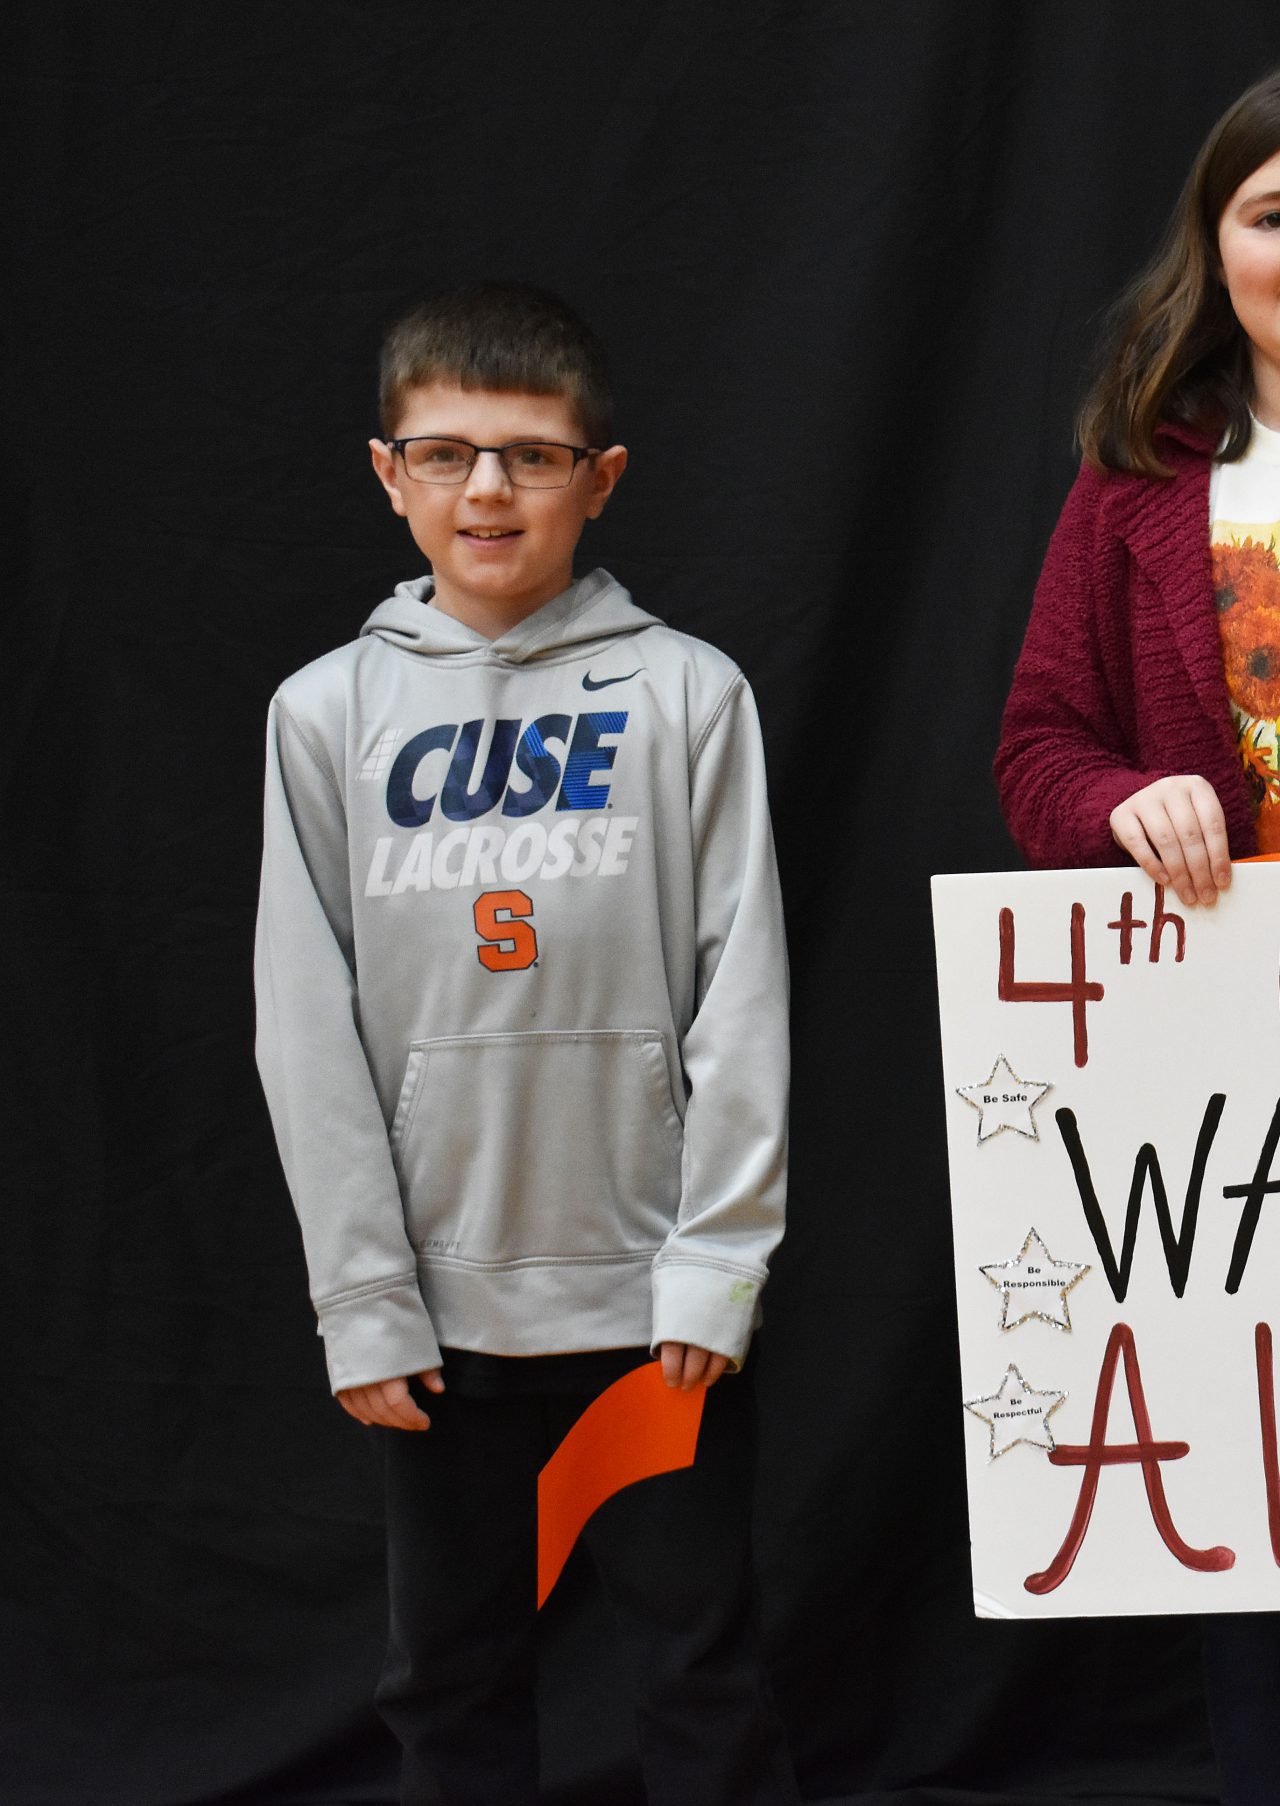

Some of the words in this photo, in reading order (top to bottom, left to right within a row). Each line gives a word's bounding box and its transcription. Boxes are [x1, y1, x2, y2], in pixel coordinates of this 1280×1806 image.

[386, 711, 629, 828] CUSE
[364, 816, 640, 898] LACROSSE
[473, 889, 539, 973] S
[998, 882, 1186, 1068] 4th
[983, 1095, 999, 1104] Be
[1002, 1093, 1028, 1103] Safe
[1003, 1279, 1066, 1288] Responsible
[1027, 1266, 1041, 1274] Be
[993, 1407, 1042, 1418] Respectful
